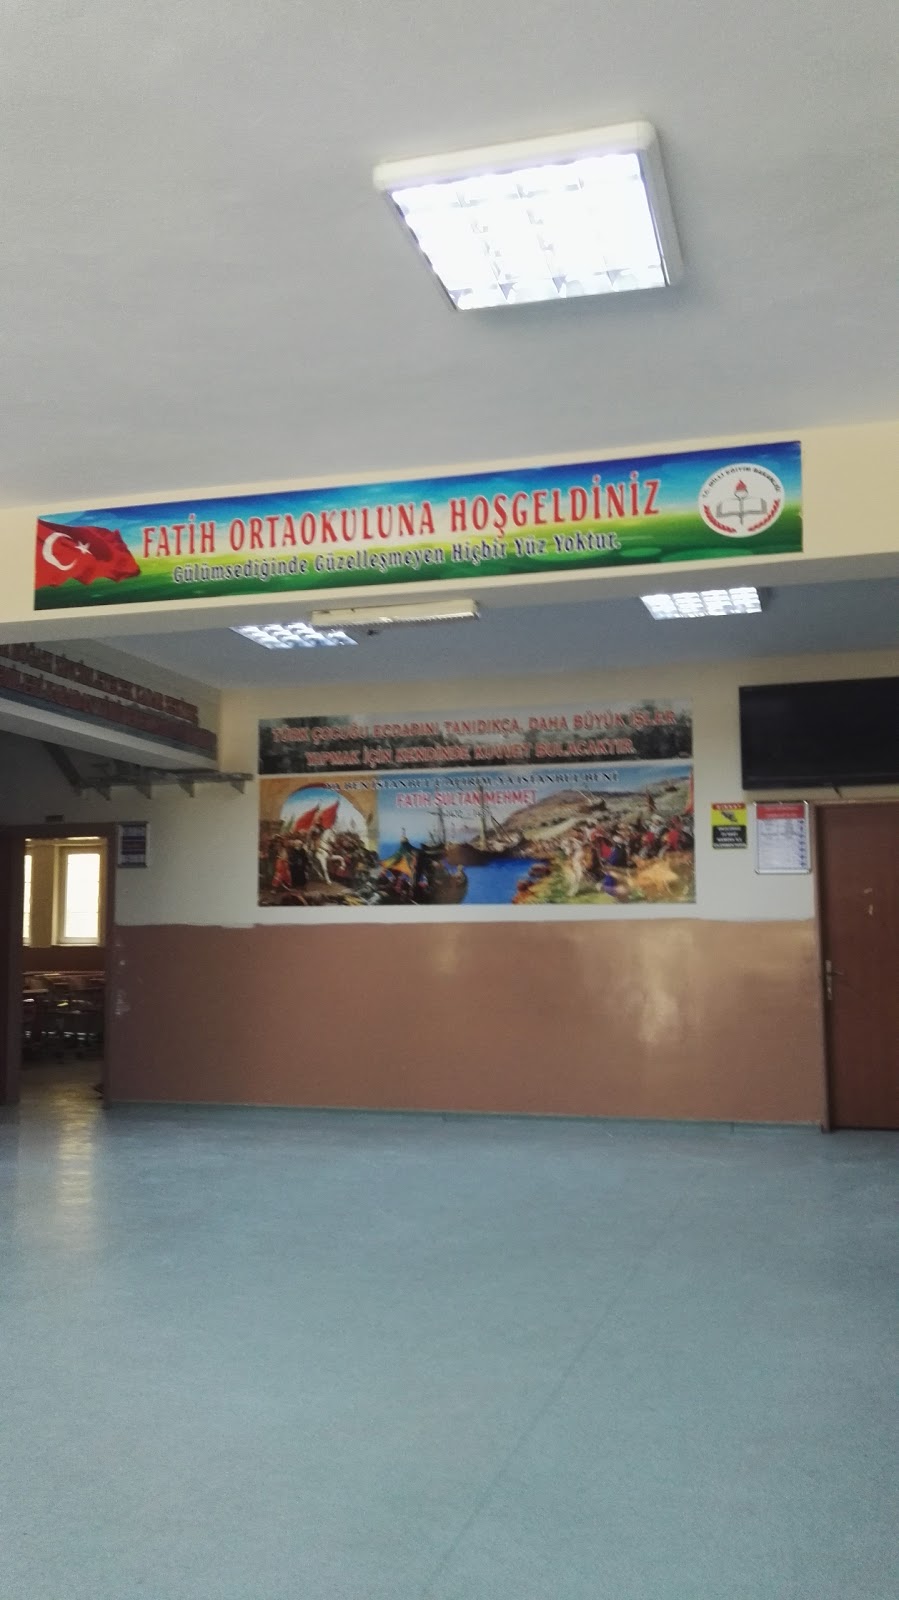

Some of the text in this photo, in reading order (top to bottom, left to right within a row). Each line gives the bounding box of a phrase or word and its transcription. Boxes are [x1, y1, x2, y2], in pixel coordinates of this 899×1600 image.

[143, 471, 660, 558] FATİH ORTAOKULUNA HOŞGELDİNİZ
[173, 531, 621, 583] Gülümsediğinde Güzelleşmeyen Hiçbir Yüz Yoktur.
[528, 715, 568, 730] DAHA
[573, 709, 626, 730] BÜYÜK
